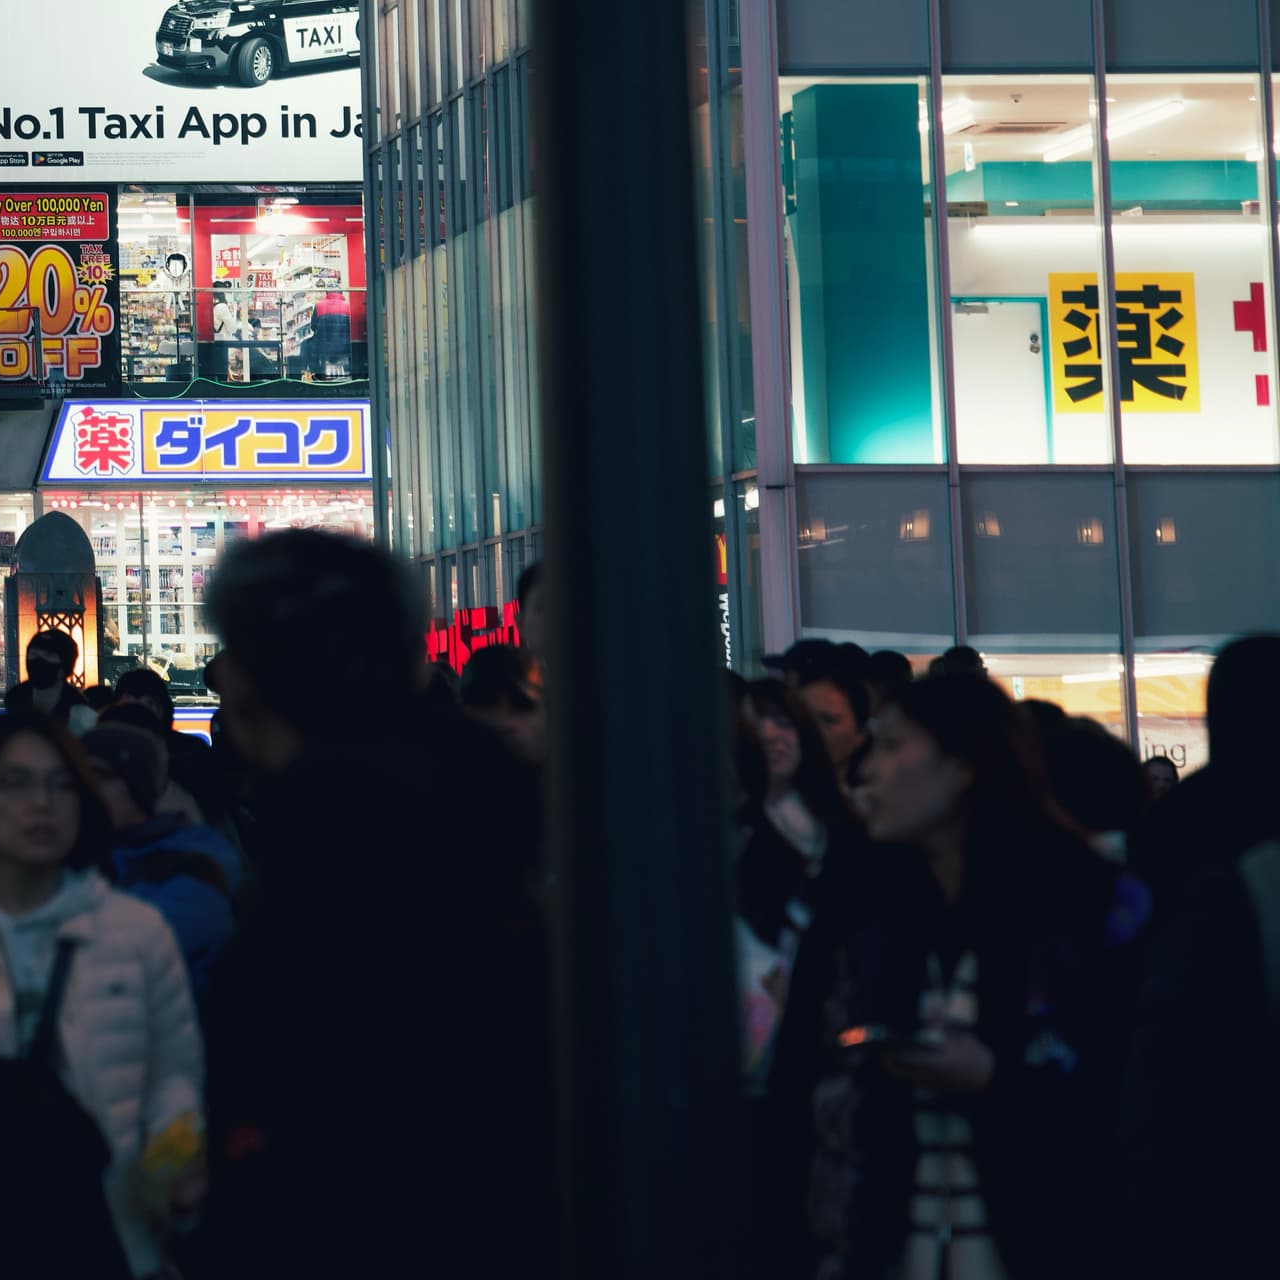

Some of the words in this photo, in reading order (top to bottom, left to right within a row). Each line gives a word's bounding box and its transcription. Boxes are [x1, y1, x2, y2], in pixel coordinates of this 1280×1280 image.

[296, 24, 342, 49] TAXI
[78, 105, 164, 140] Taxi
[178, 106, 268, 147] App
[281, 105, 317, 139] in
[5, 199, 33, 213] Over
[36, 198, 81, 213] 100,000
[82, 198, 104, 212] Yen
[80, 244, 103, 254] TAX
[81, 254, 111, 264] FREE
[1061, 283, 1189, 403] 薬
[73, 407, 135, 476] 薬
[154, 415, 352, 468] ダイコク
